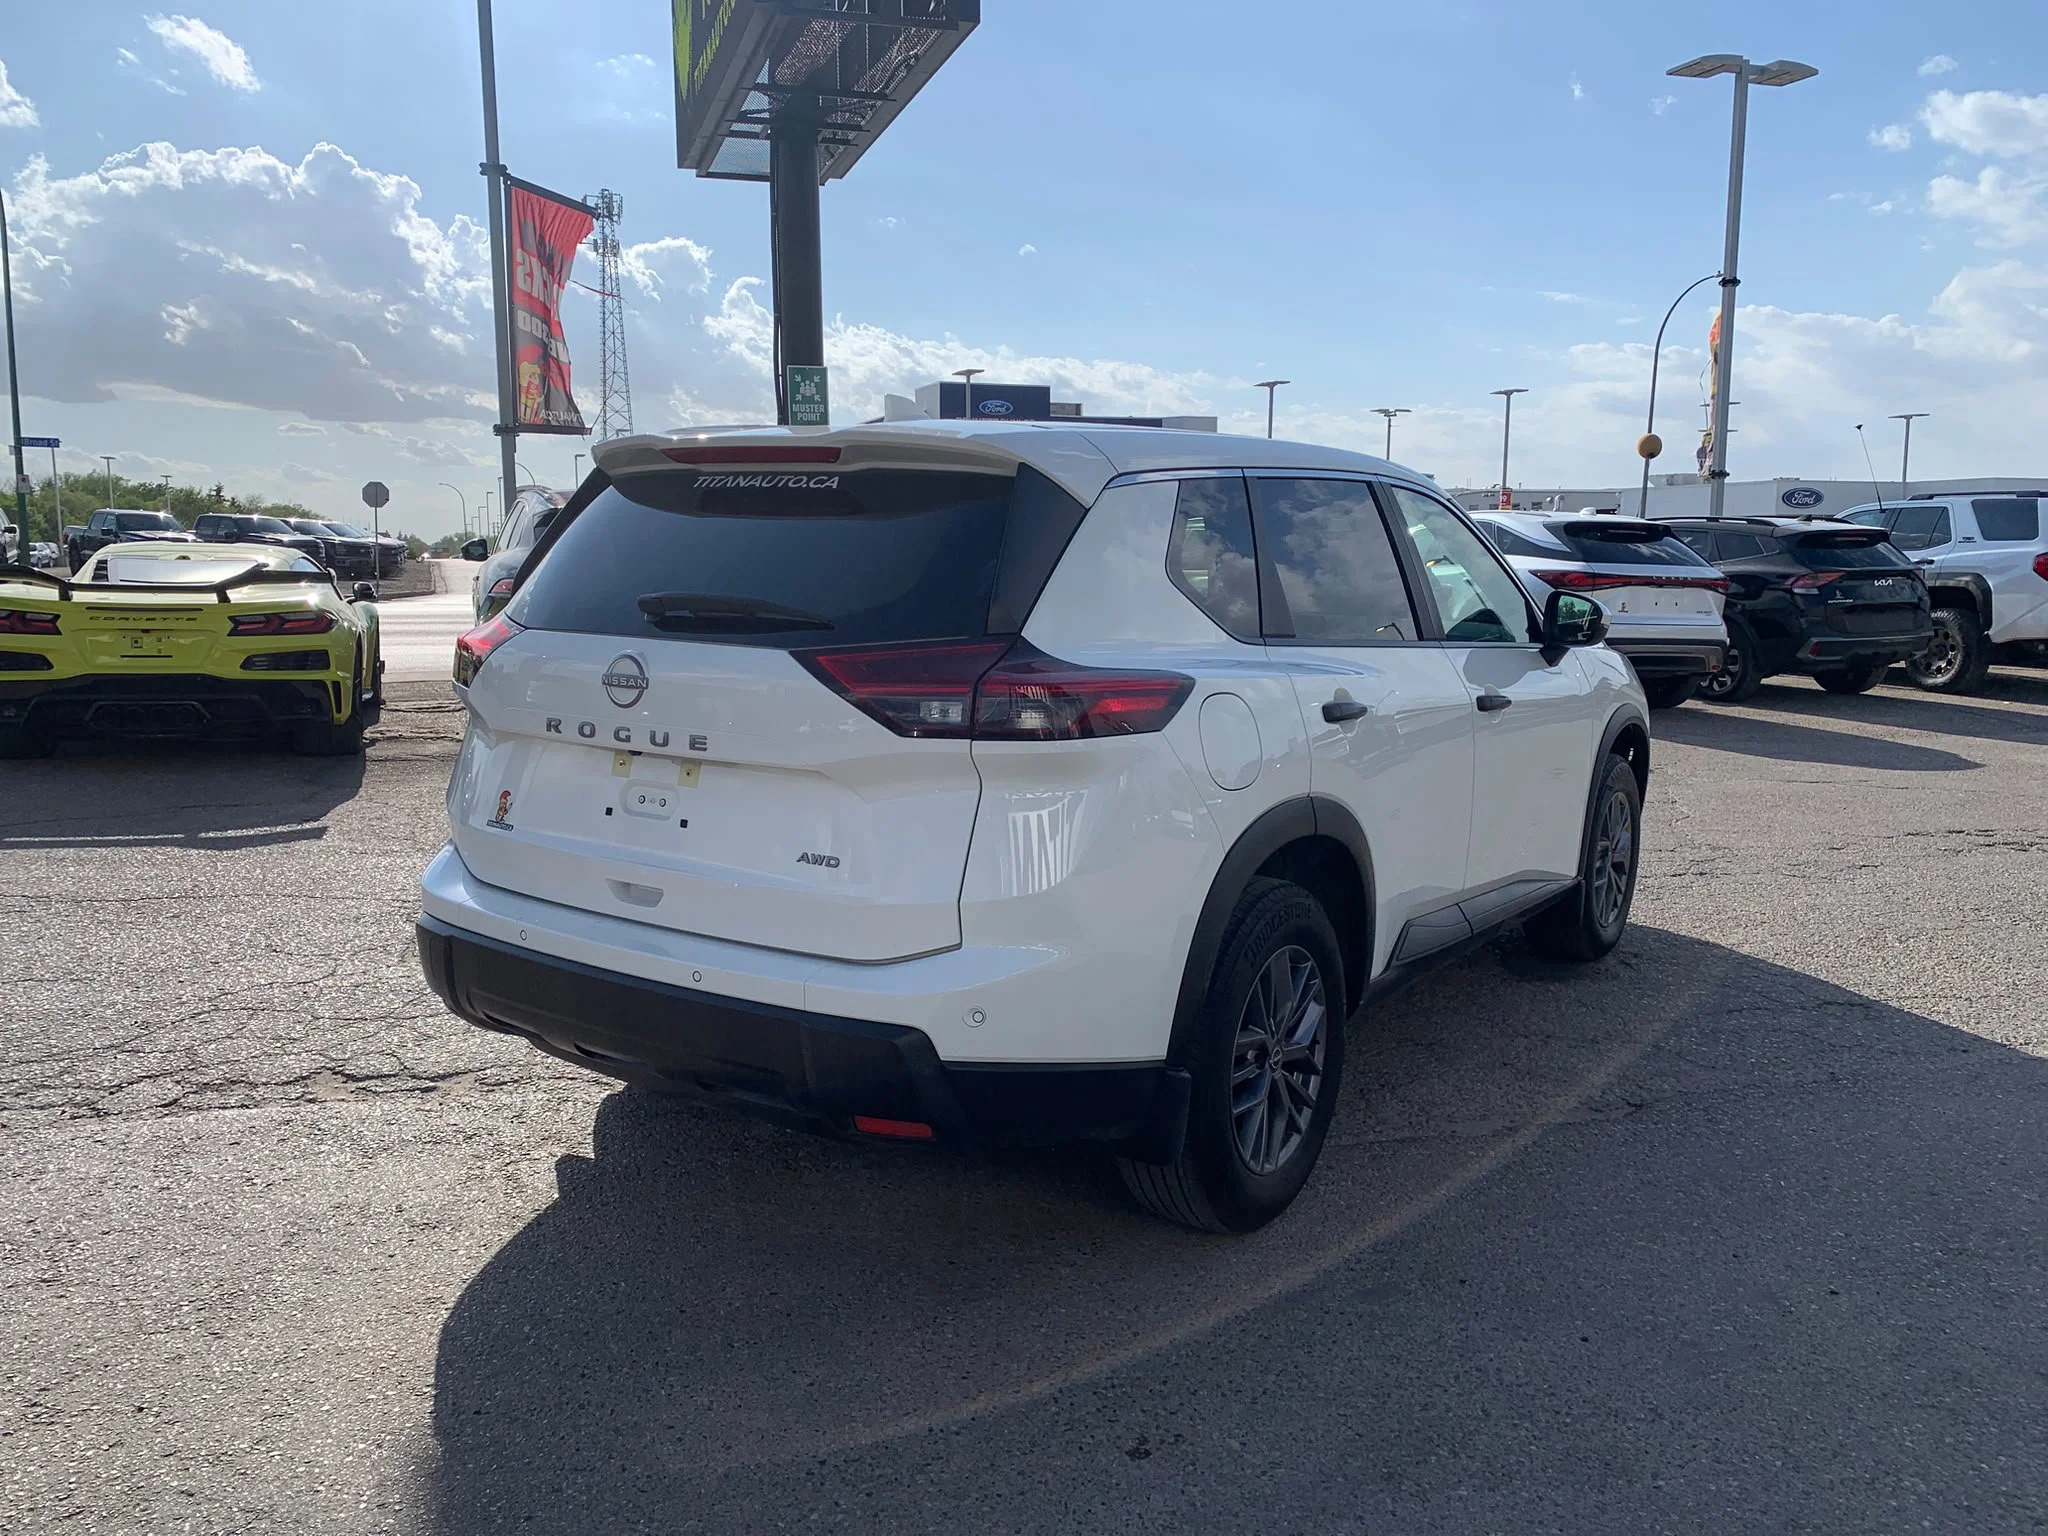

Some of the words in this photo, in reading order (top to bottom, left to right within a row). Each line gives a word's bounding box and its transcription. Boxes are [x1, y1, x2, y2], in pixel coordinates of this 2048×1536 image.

[792, 403, 825, 413] MUSTER
[983, 402, 1008, 413] Ford
[797, 412, 821, 421] POINT
[693, 475, 840, 489] TITANAUTO.CA
[1791, 490, 1817, 505] Ford
[602, 675, 648, 690] NISSAN
[546, 717, 708, 752] ROGUE
[796, 851, 841, 869] AWD
